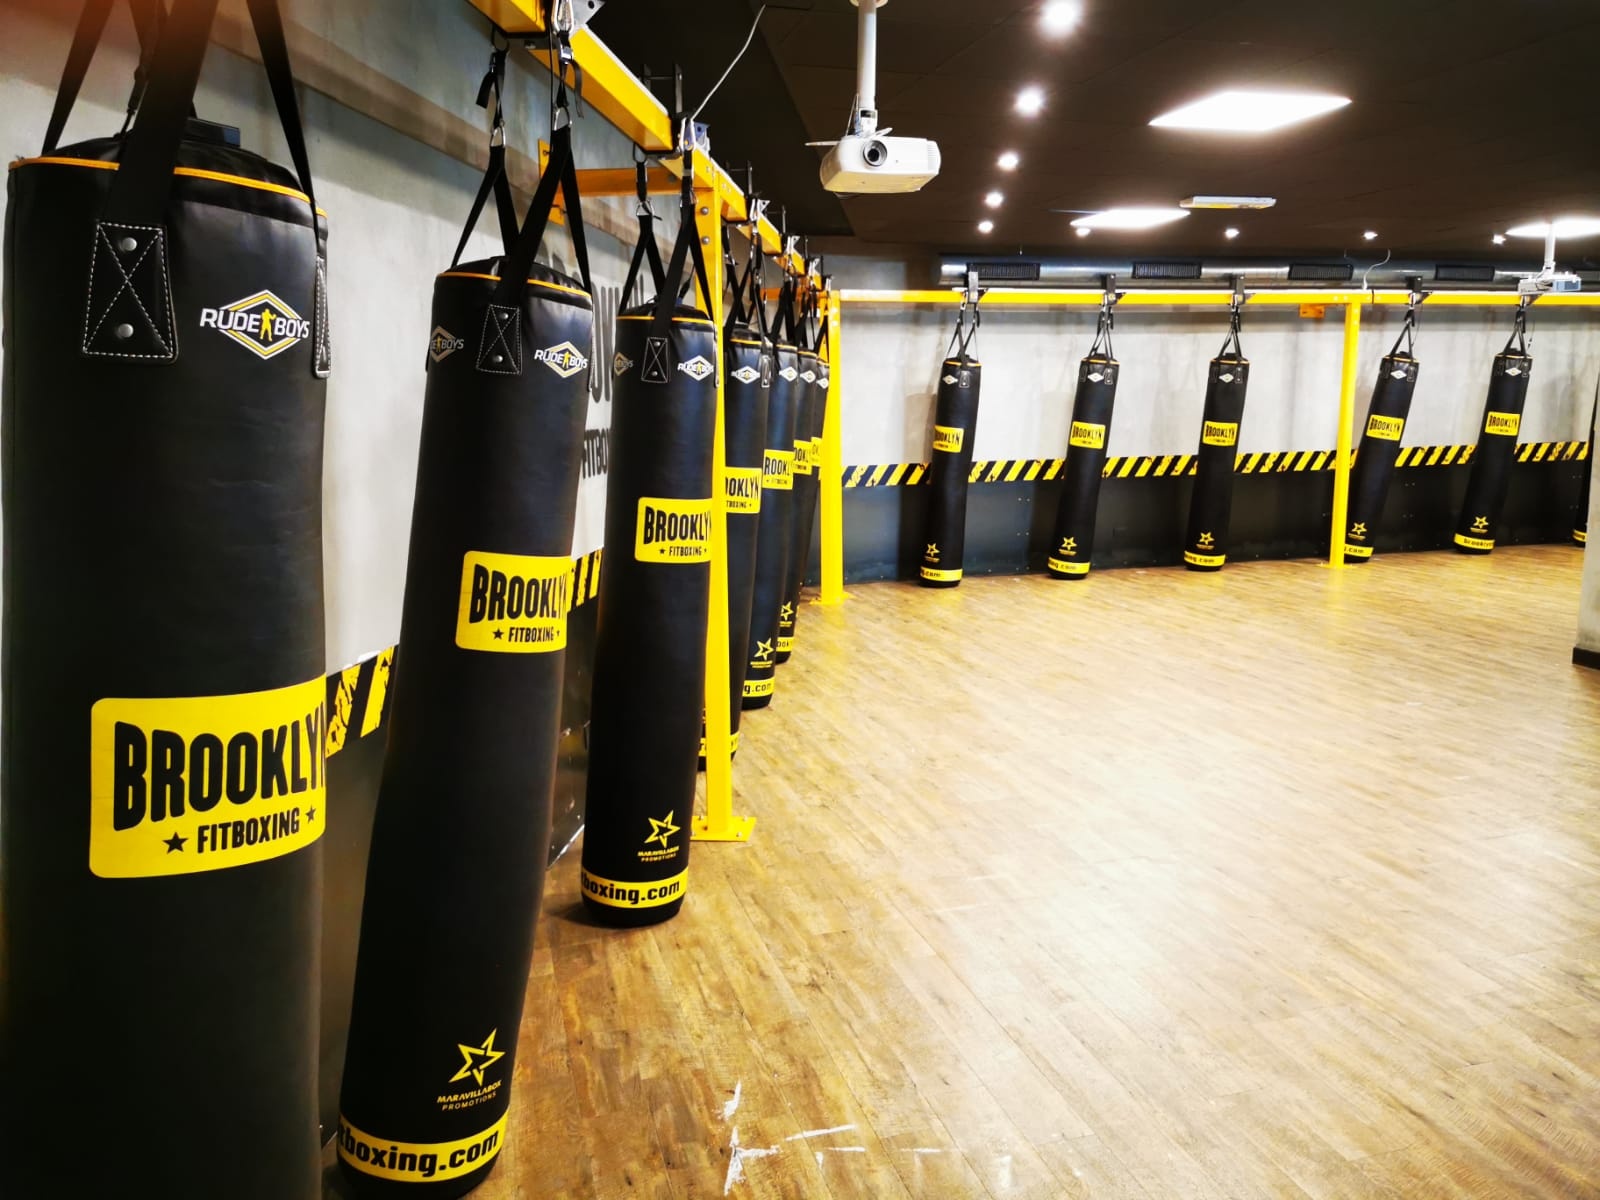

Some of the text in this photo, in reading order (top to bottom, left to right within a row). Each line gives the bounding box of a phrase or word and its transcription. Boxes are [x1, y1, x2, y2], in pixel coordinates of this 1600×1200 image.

[199, 307, 310, 339] RUDE BOYS
[442, 338, 465, 350] BOYS
[534, 349, 564, 364] RUDE
[669, 546, 702, 556] FITBOXING
[508, 626, 554, 643] FITBOXING
[197, 807, 300, 854] FITBOXING
[436, 1079, 502, 1104] MARAVILLABOX
[441, 1092, 497, 1111] PROMOTIONS
